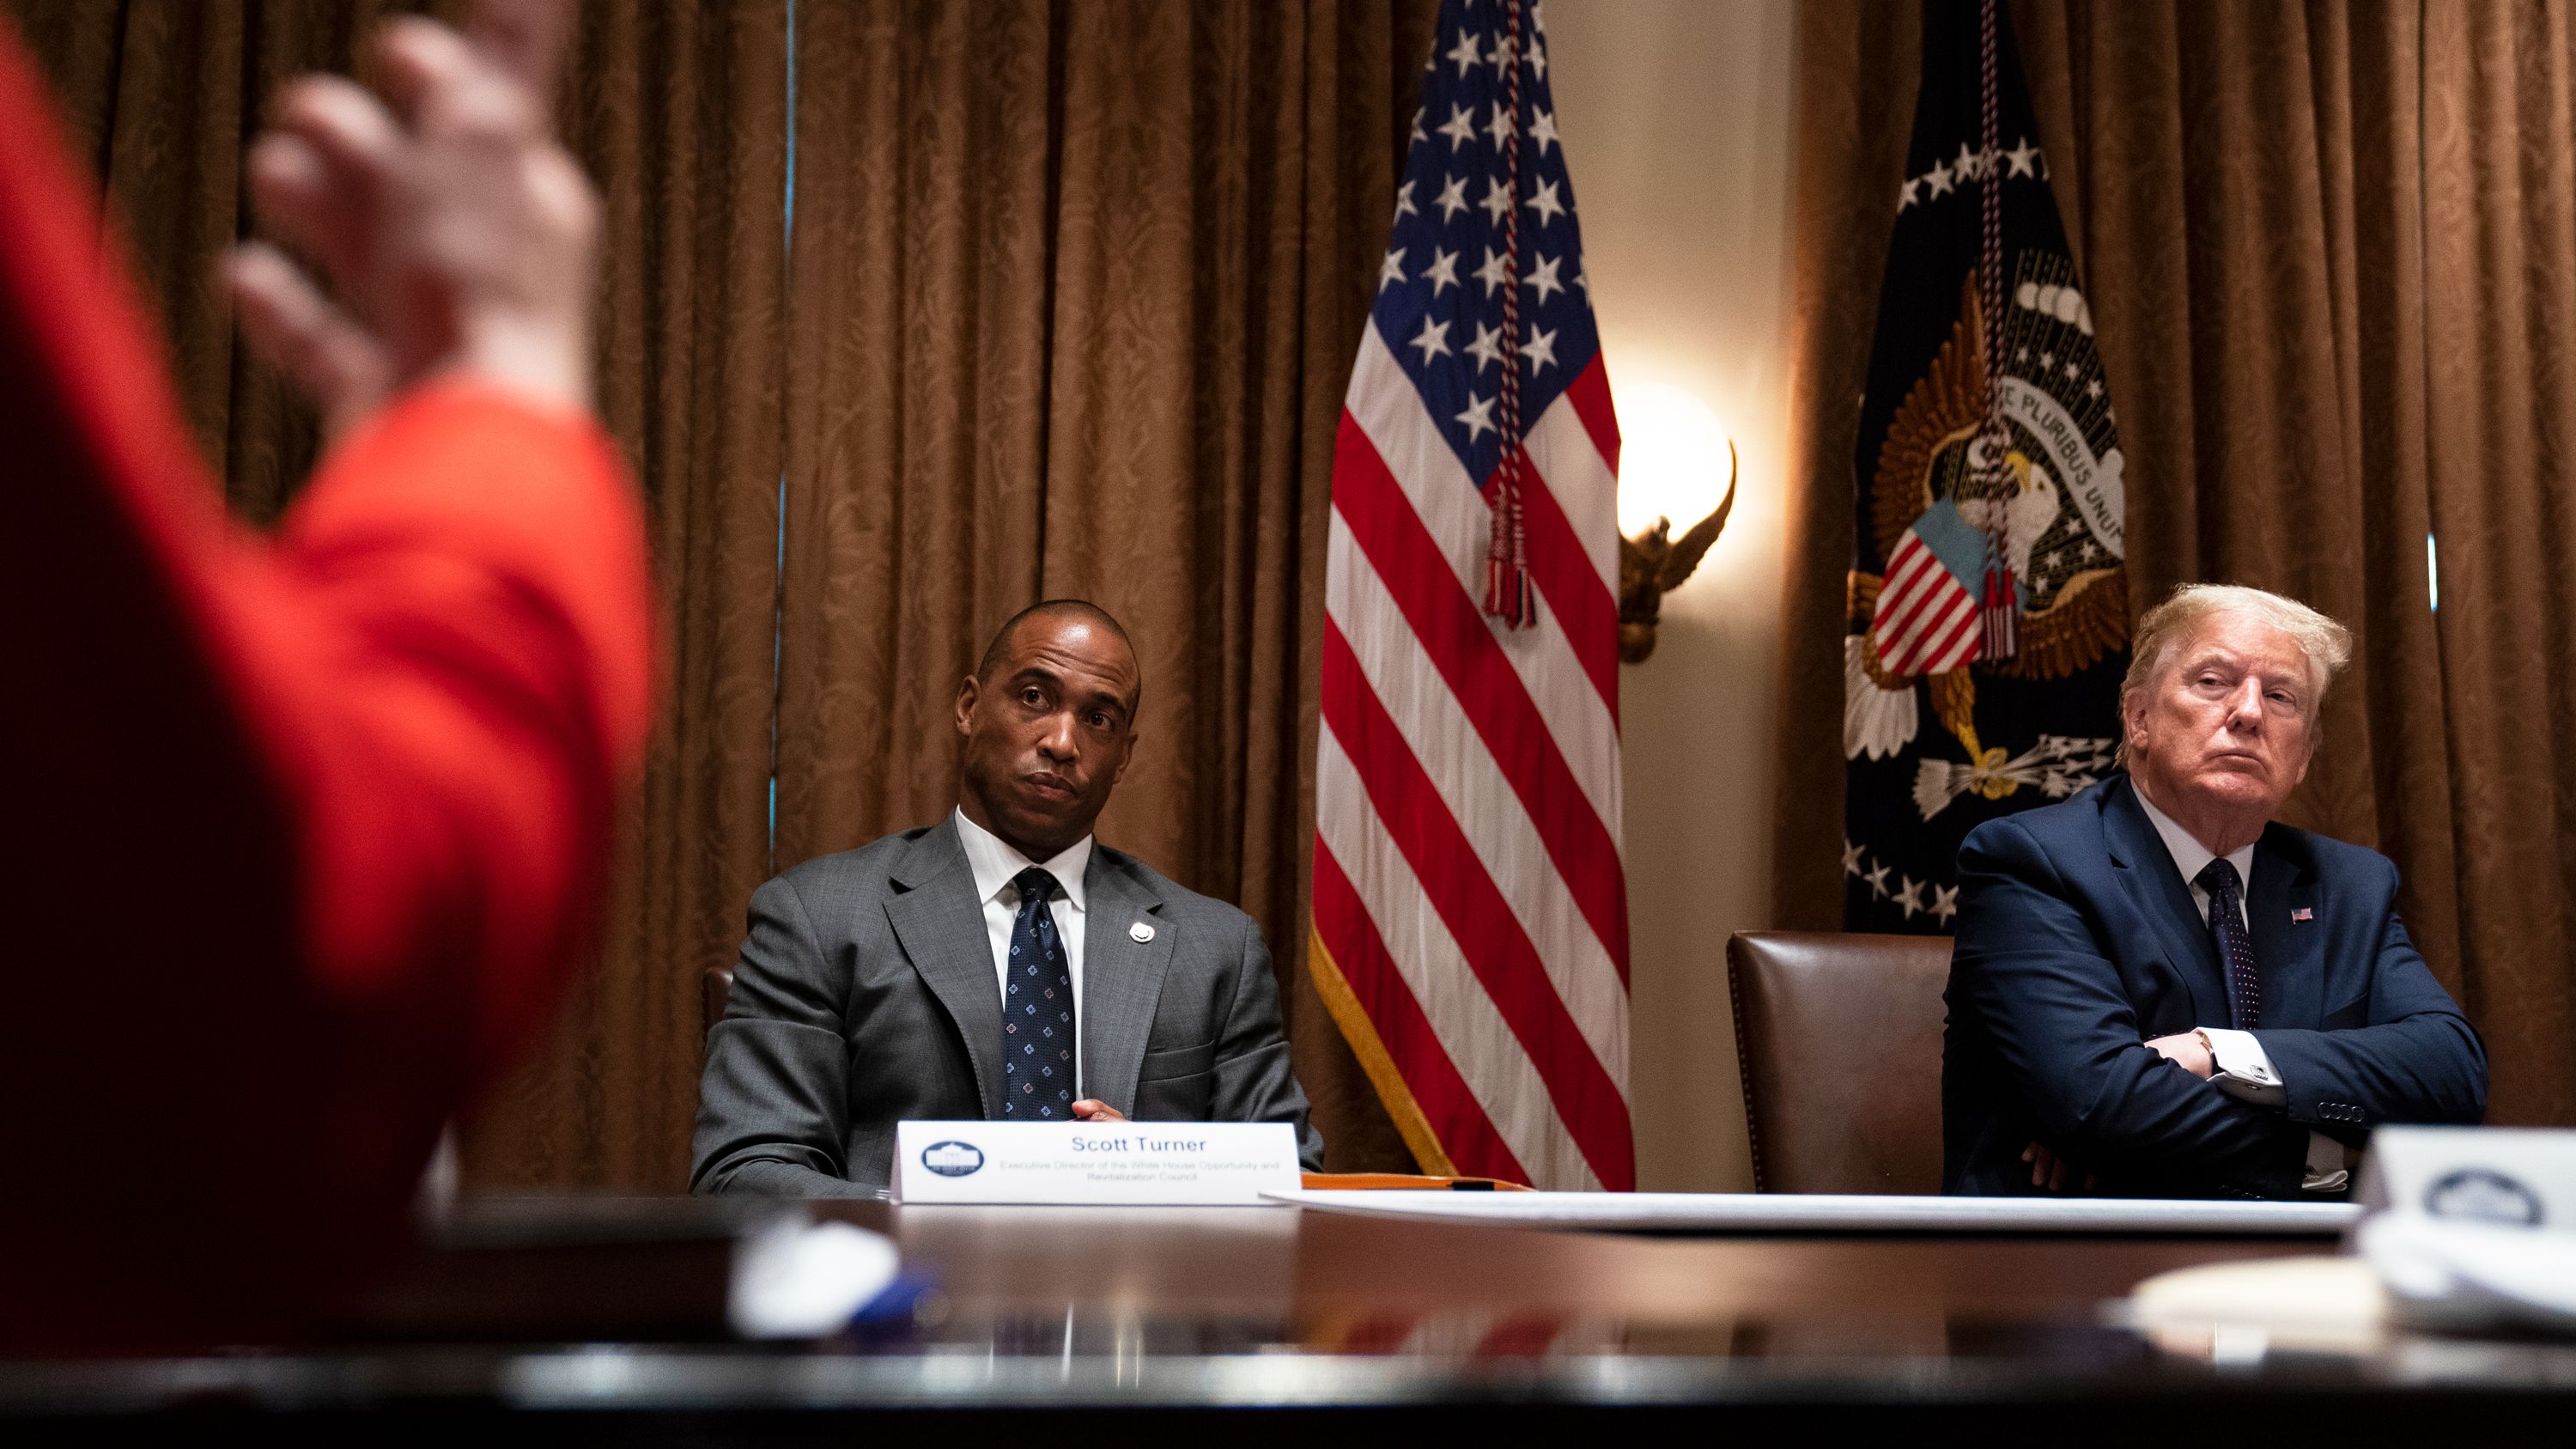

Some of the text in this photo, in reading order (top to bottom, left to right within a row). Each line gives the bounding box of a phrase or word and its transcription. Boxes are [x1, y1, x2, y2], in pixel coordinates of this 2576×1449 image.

[2020, 393, 2093, 486] PLURIBUS
[1072, 1136, 1206, 1152] Scott Turner
[999, 1160, 1279, 1172] Executive Director of the White House Opportunity and
[1087, 1172, 1198, 1181] Revitalization Council
